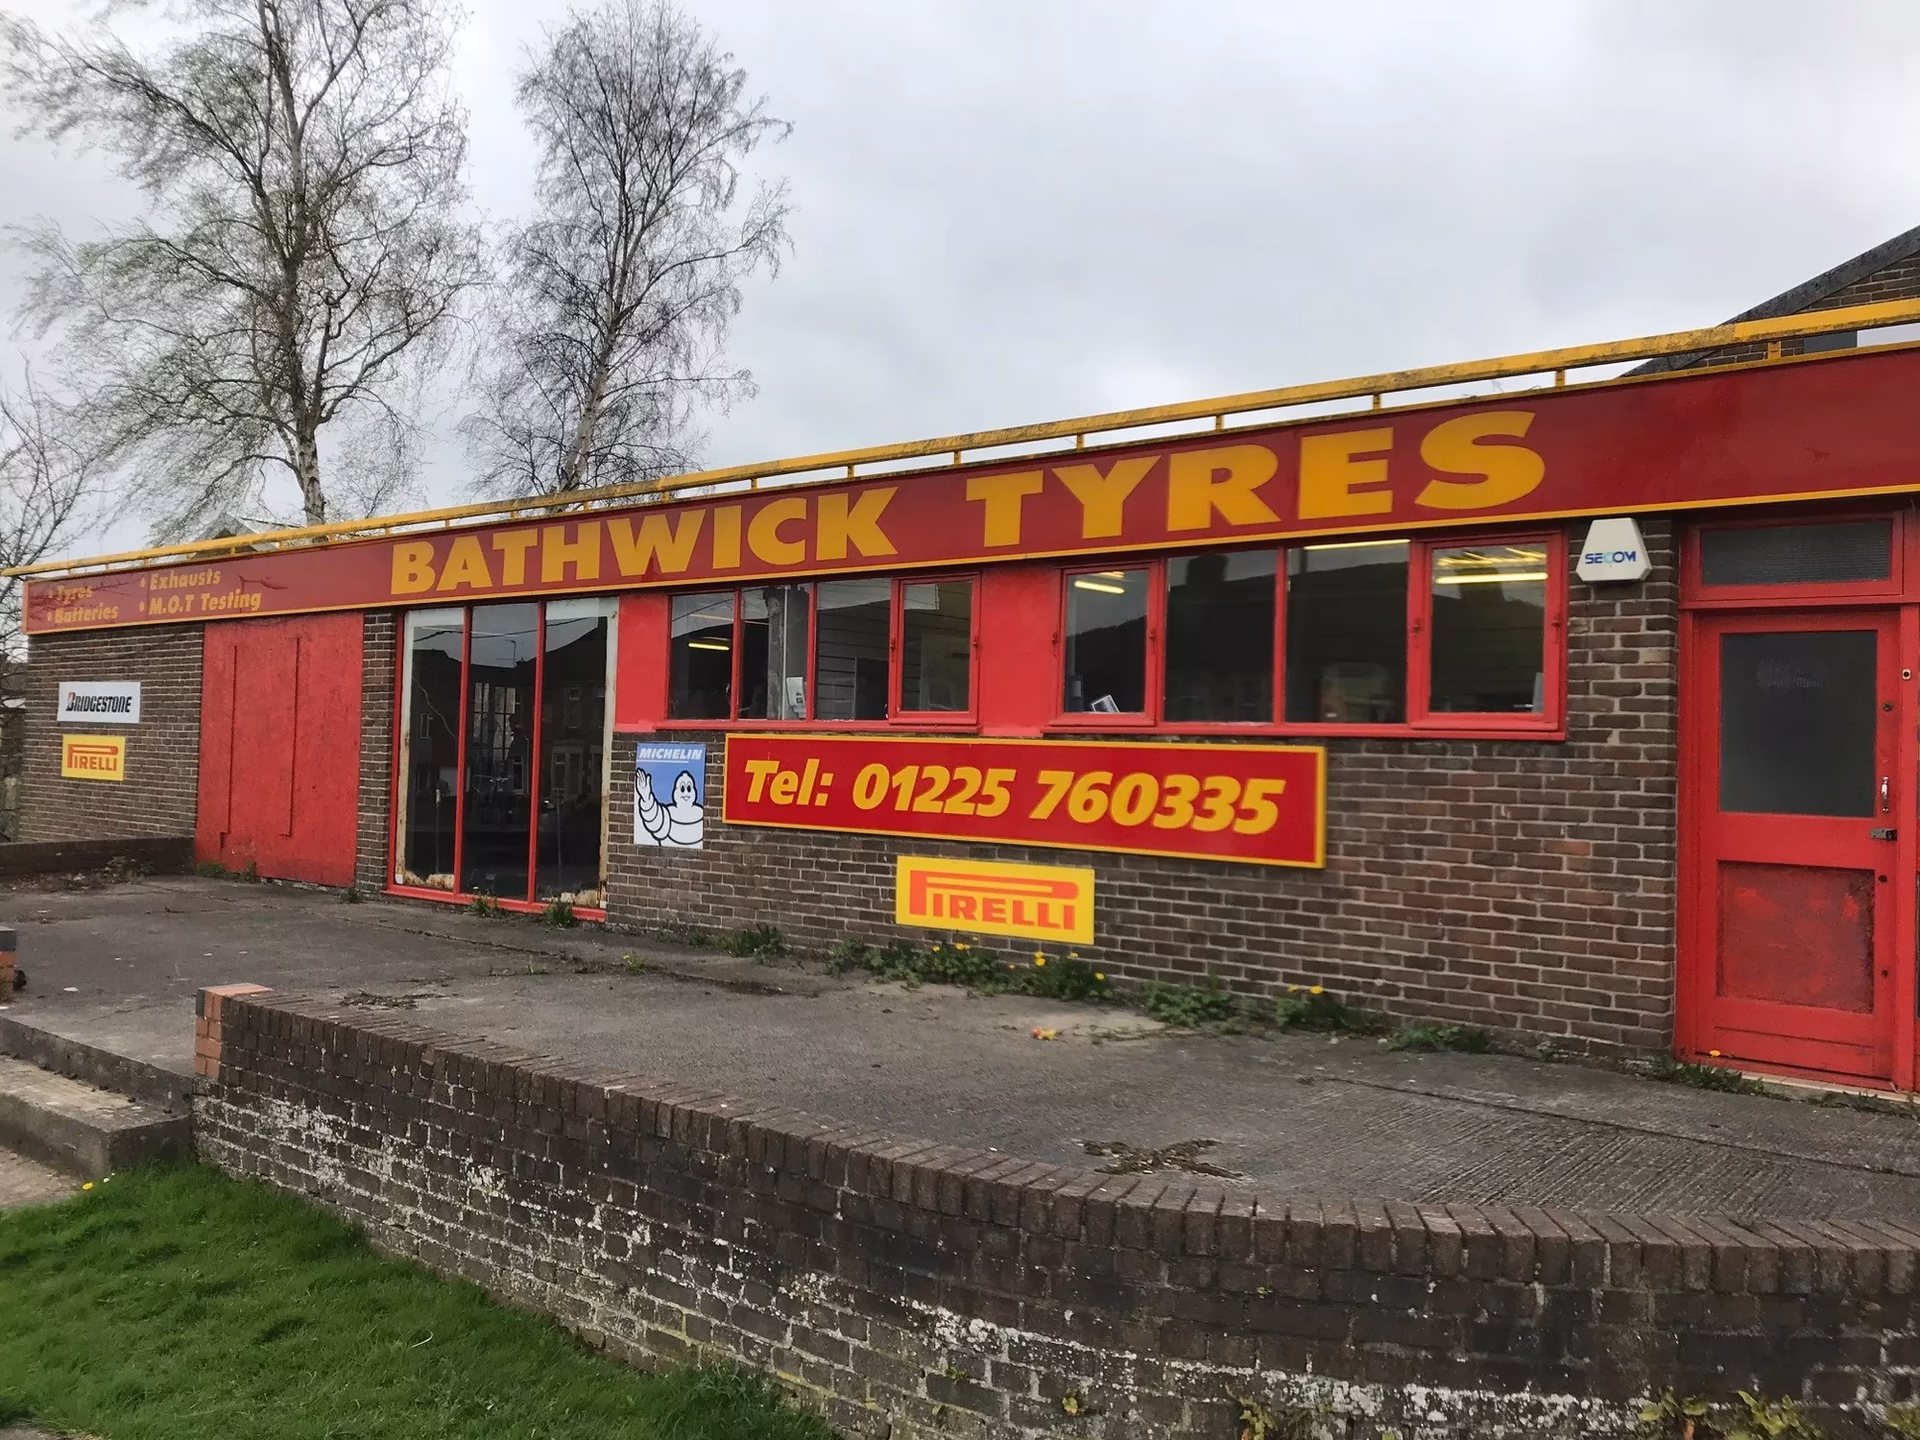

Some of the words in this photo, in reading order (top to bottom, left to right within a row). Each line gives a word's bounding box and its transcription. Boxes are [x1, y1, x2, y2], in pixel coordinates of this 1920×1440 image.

[390, 487, 898, 595] BATHWICK
[966, 411, 1546, 547] TYRES
[1585, 551, 1636, 564] SECOM
[149, 568, 221, 590] Exhausts
[56, 585, 93, 602] Tyres
[149, 595, 195, 616] M.O.T
[200, 589, 261, 612] Testing
[54, 603, 118, 625] Batteries
[65, 691, 131, 713] BRIDGESTONE
[67, 744, 119, 772] PIRELLI
[638, 747, 702, 761] MICHELIN
[743, 758, 834, 807] Tel:
[852, 763, 1016, 818] 01225
[1028, 770, 1287, 834] 760335
[909, 869, 1080, 930] PIRELLI
